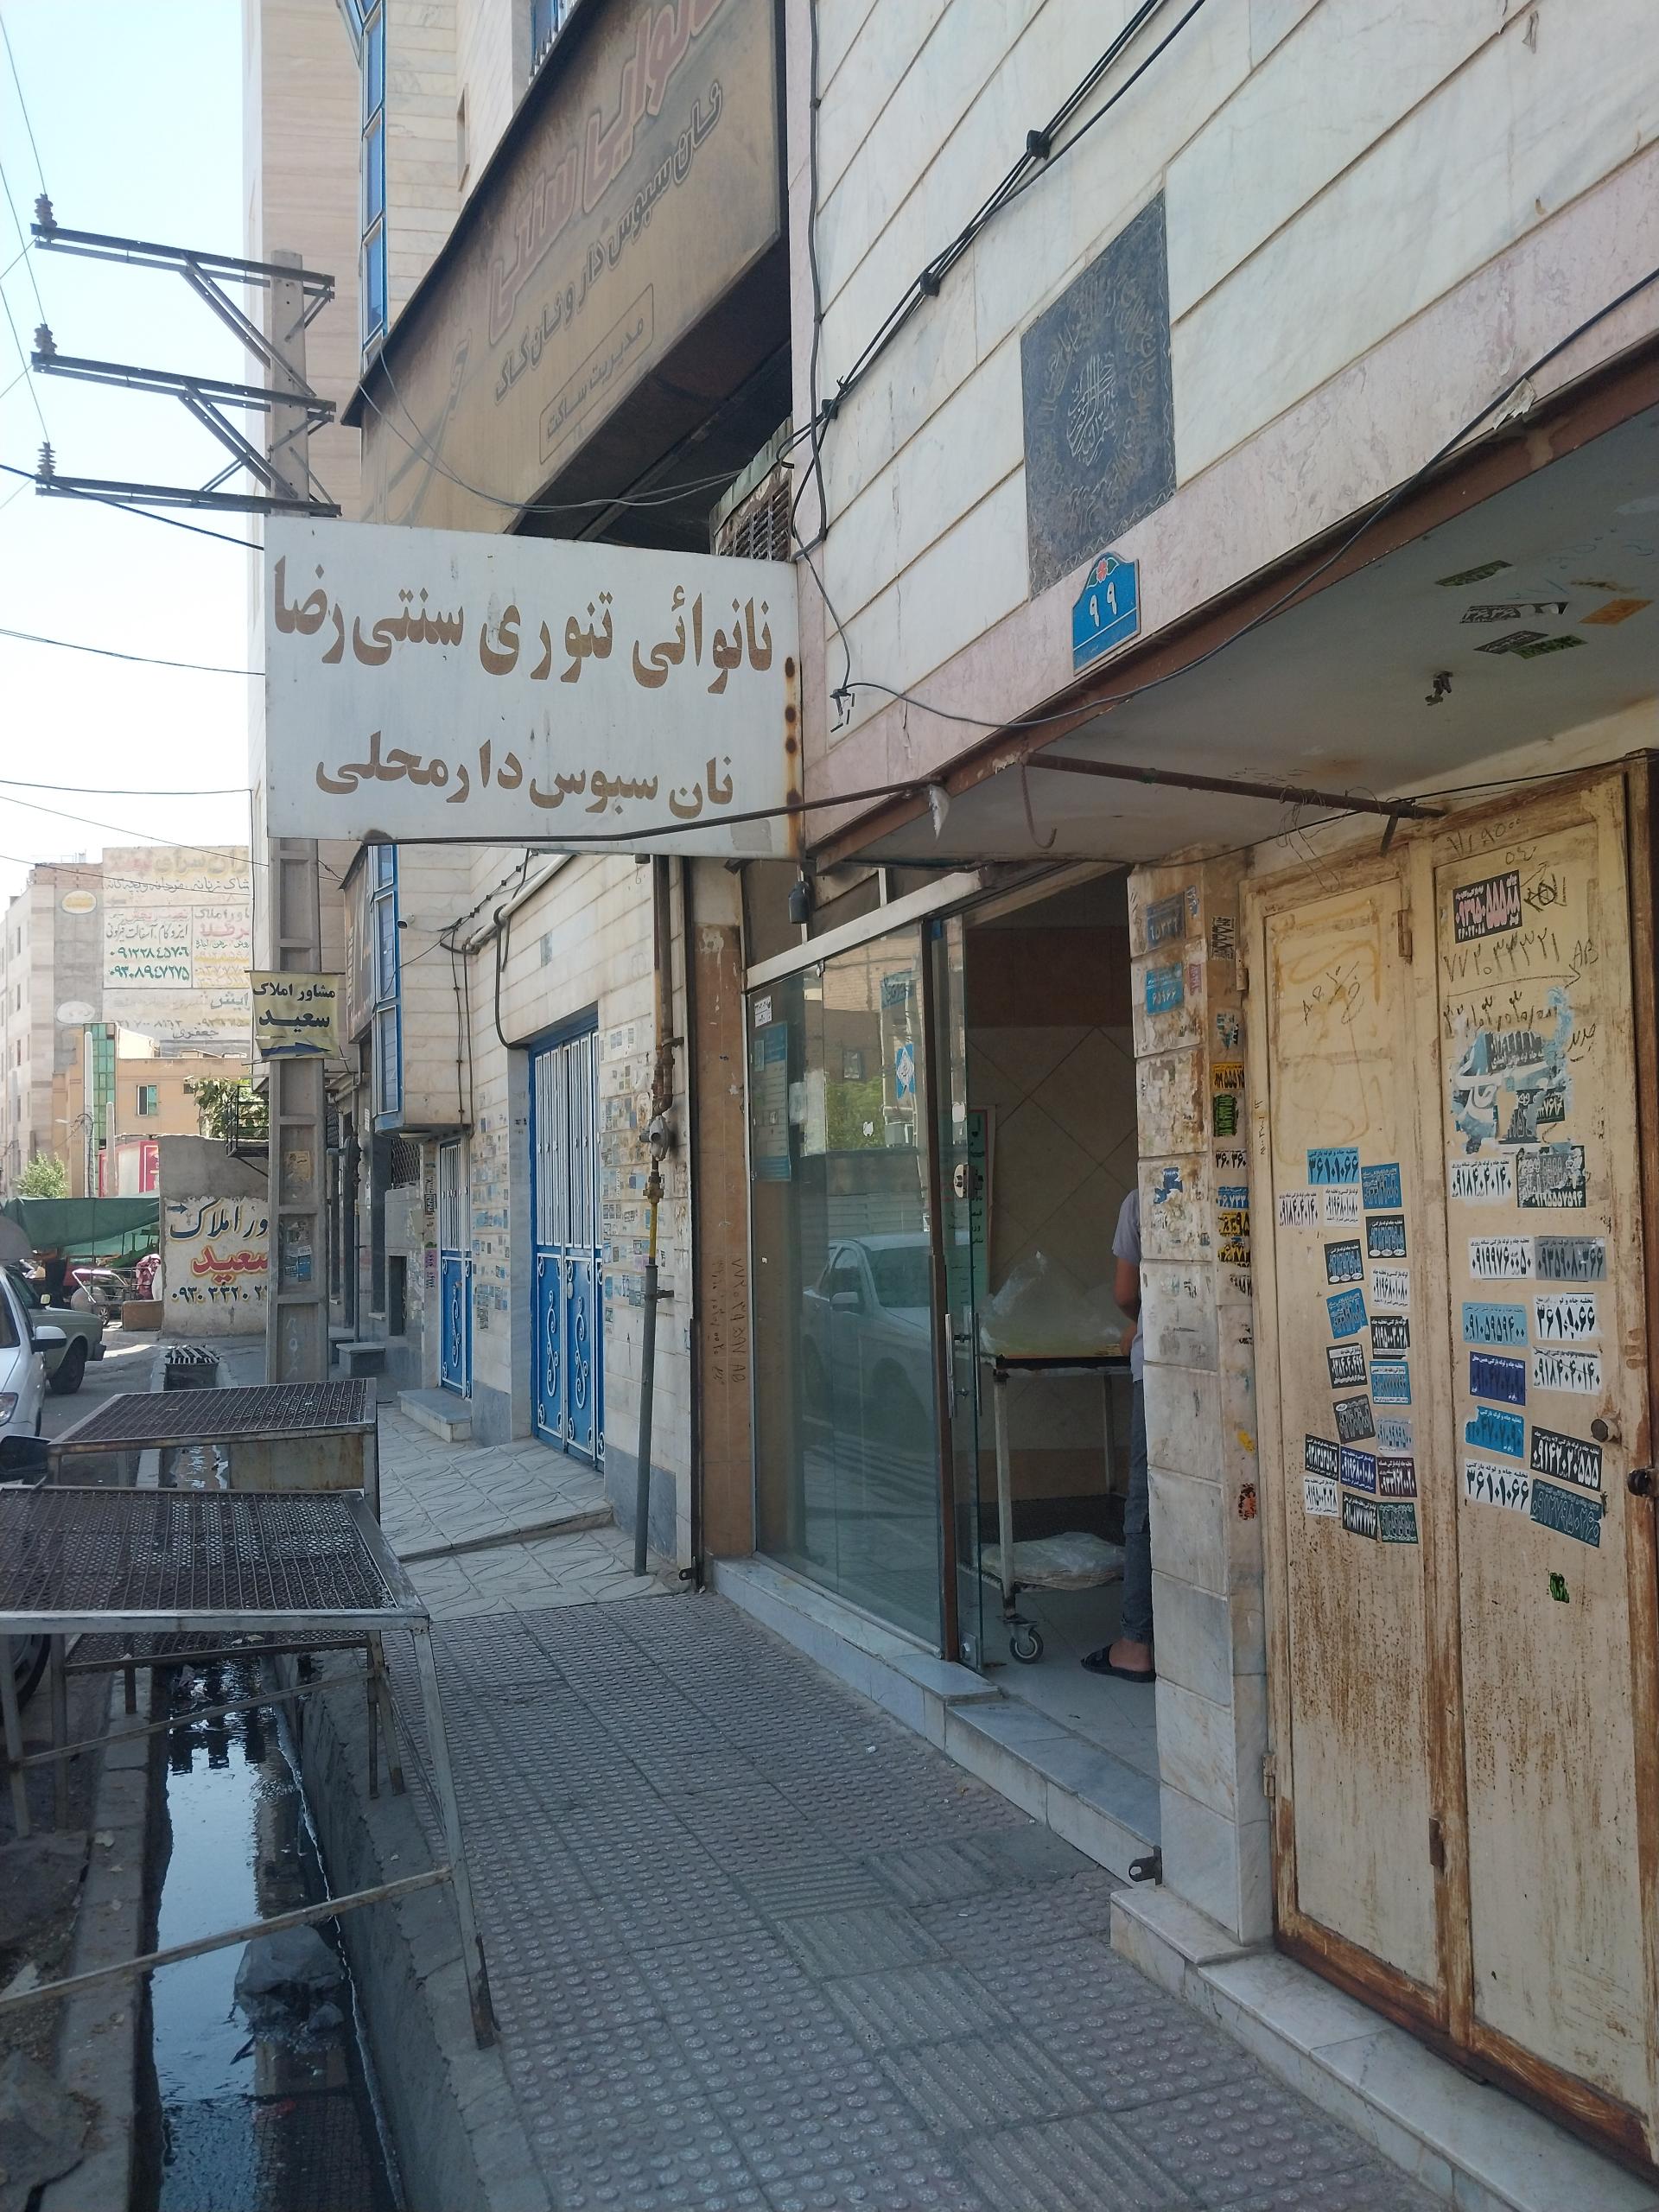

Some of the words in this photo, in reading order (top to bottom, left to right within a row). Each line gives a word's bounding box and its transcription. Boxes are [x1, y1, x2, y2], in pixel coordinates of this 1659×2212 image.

[274, 555, 345, 664] رضا
[352, 587, 465, 667] سنتی
[1090, 582, 1118, 628] ۹۹
[479, 591, 614, 683] تنوری
[315, 730, 449, 796] محلی
[529, 768, 659, 816] سبوس
[669, 755, 734, 820] نان
[252, 982, 294, 996] املاک
[296, 984, 335, 1001] مشاور
[258, 1009, 330, 1033] سعید
[1308, 1155, 1359, 1184] ۳۶۱۰۱۰۶۶
[169, 1196, 240, 1240] املاک
[192, 1246, 268, 1283] سعید
[1466, 1468, 1529, 1511] ۳۶۱۰۱۰۶۶
